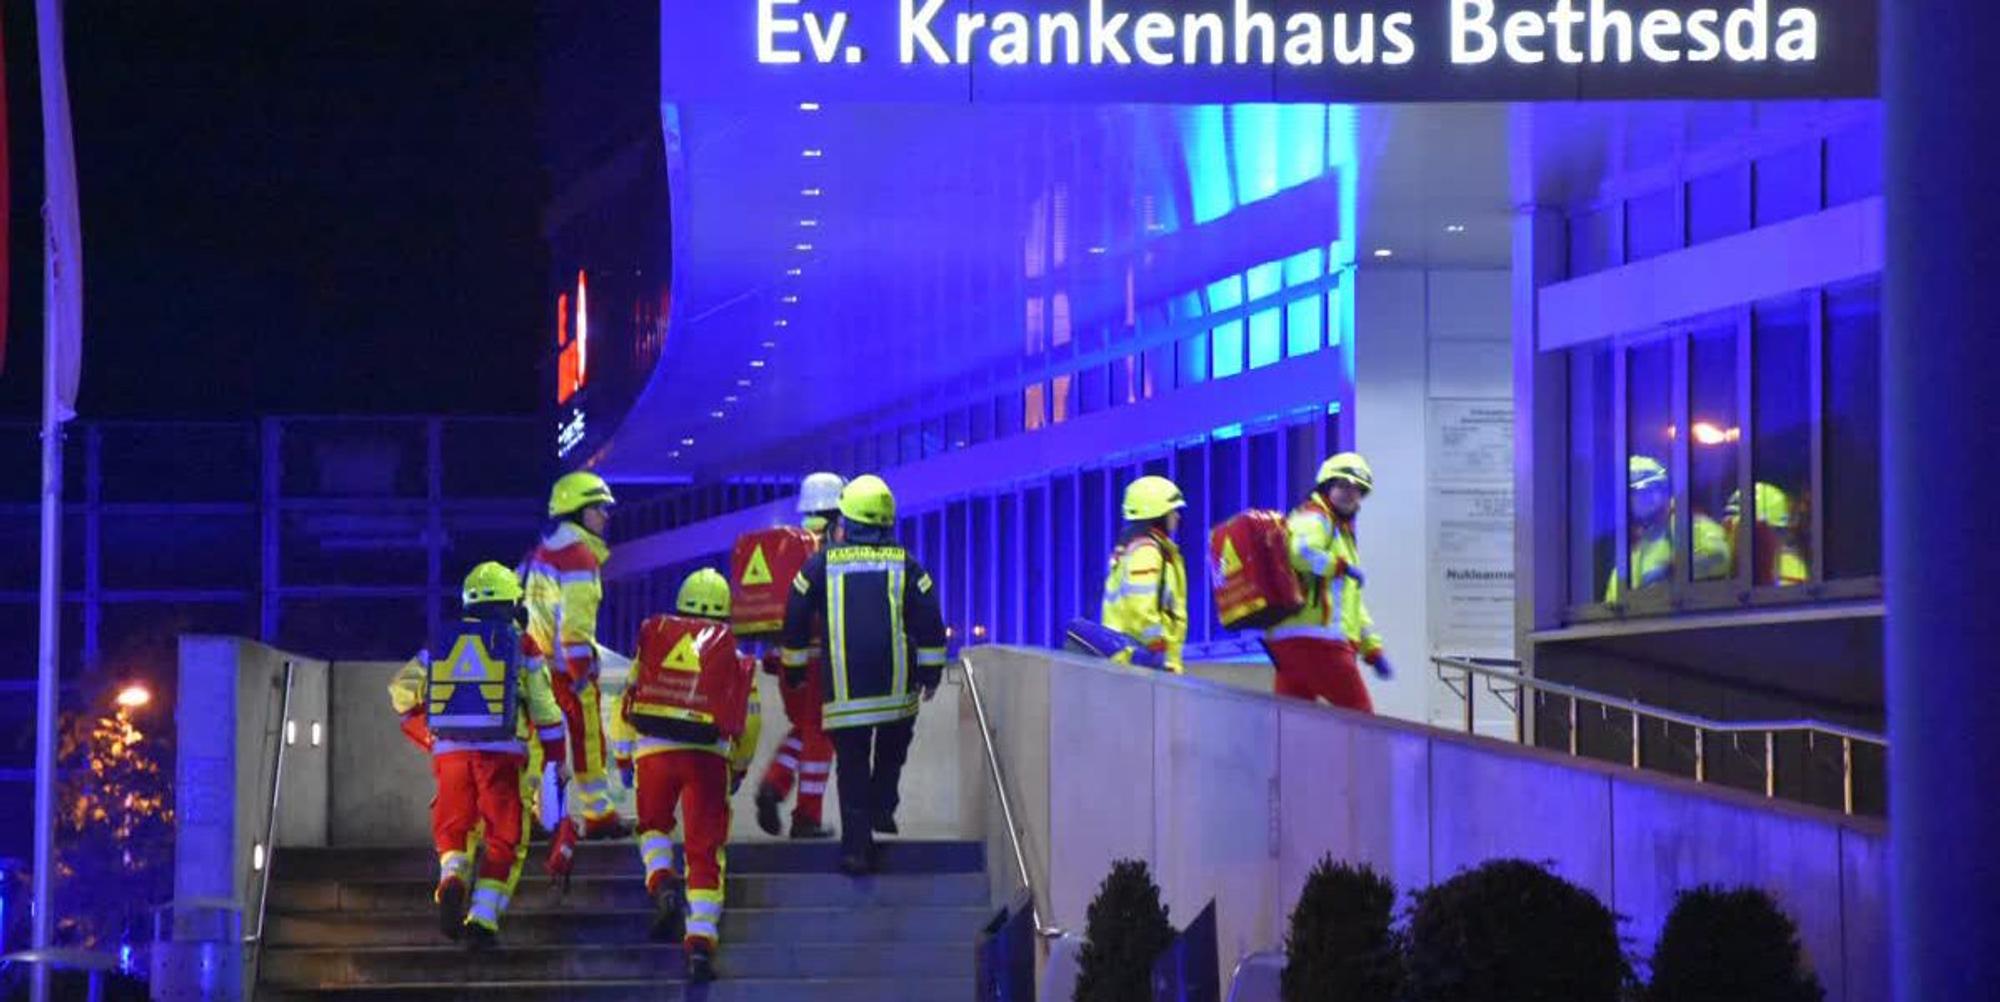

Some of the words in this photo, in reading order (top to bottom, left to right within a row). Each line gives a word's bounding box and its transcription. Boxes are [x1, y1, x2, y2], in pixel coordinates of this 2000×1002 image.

[757, 0, 861, 64] Ev.
[899, 0, 1415, 65] Krankenhaus
[1450, 0, 1818, 64] Bethesda
